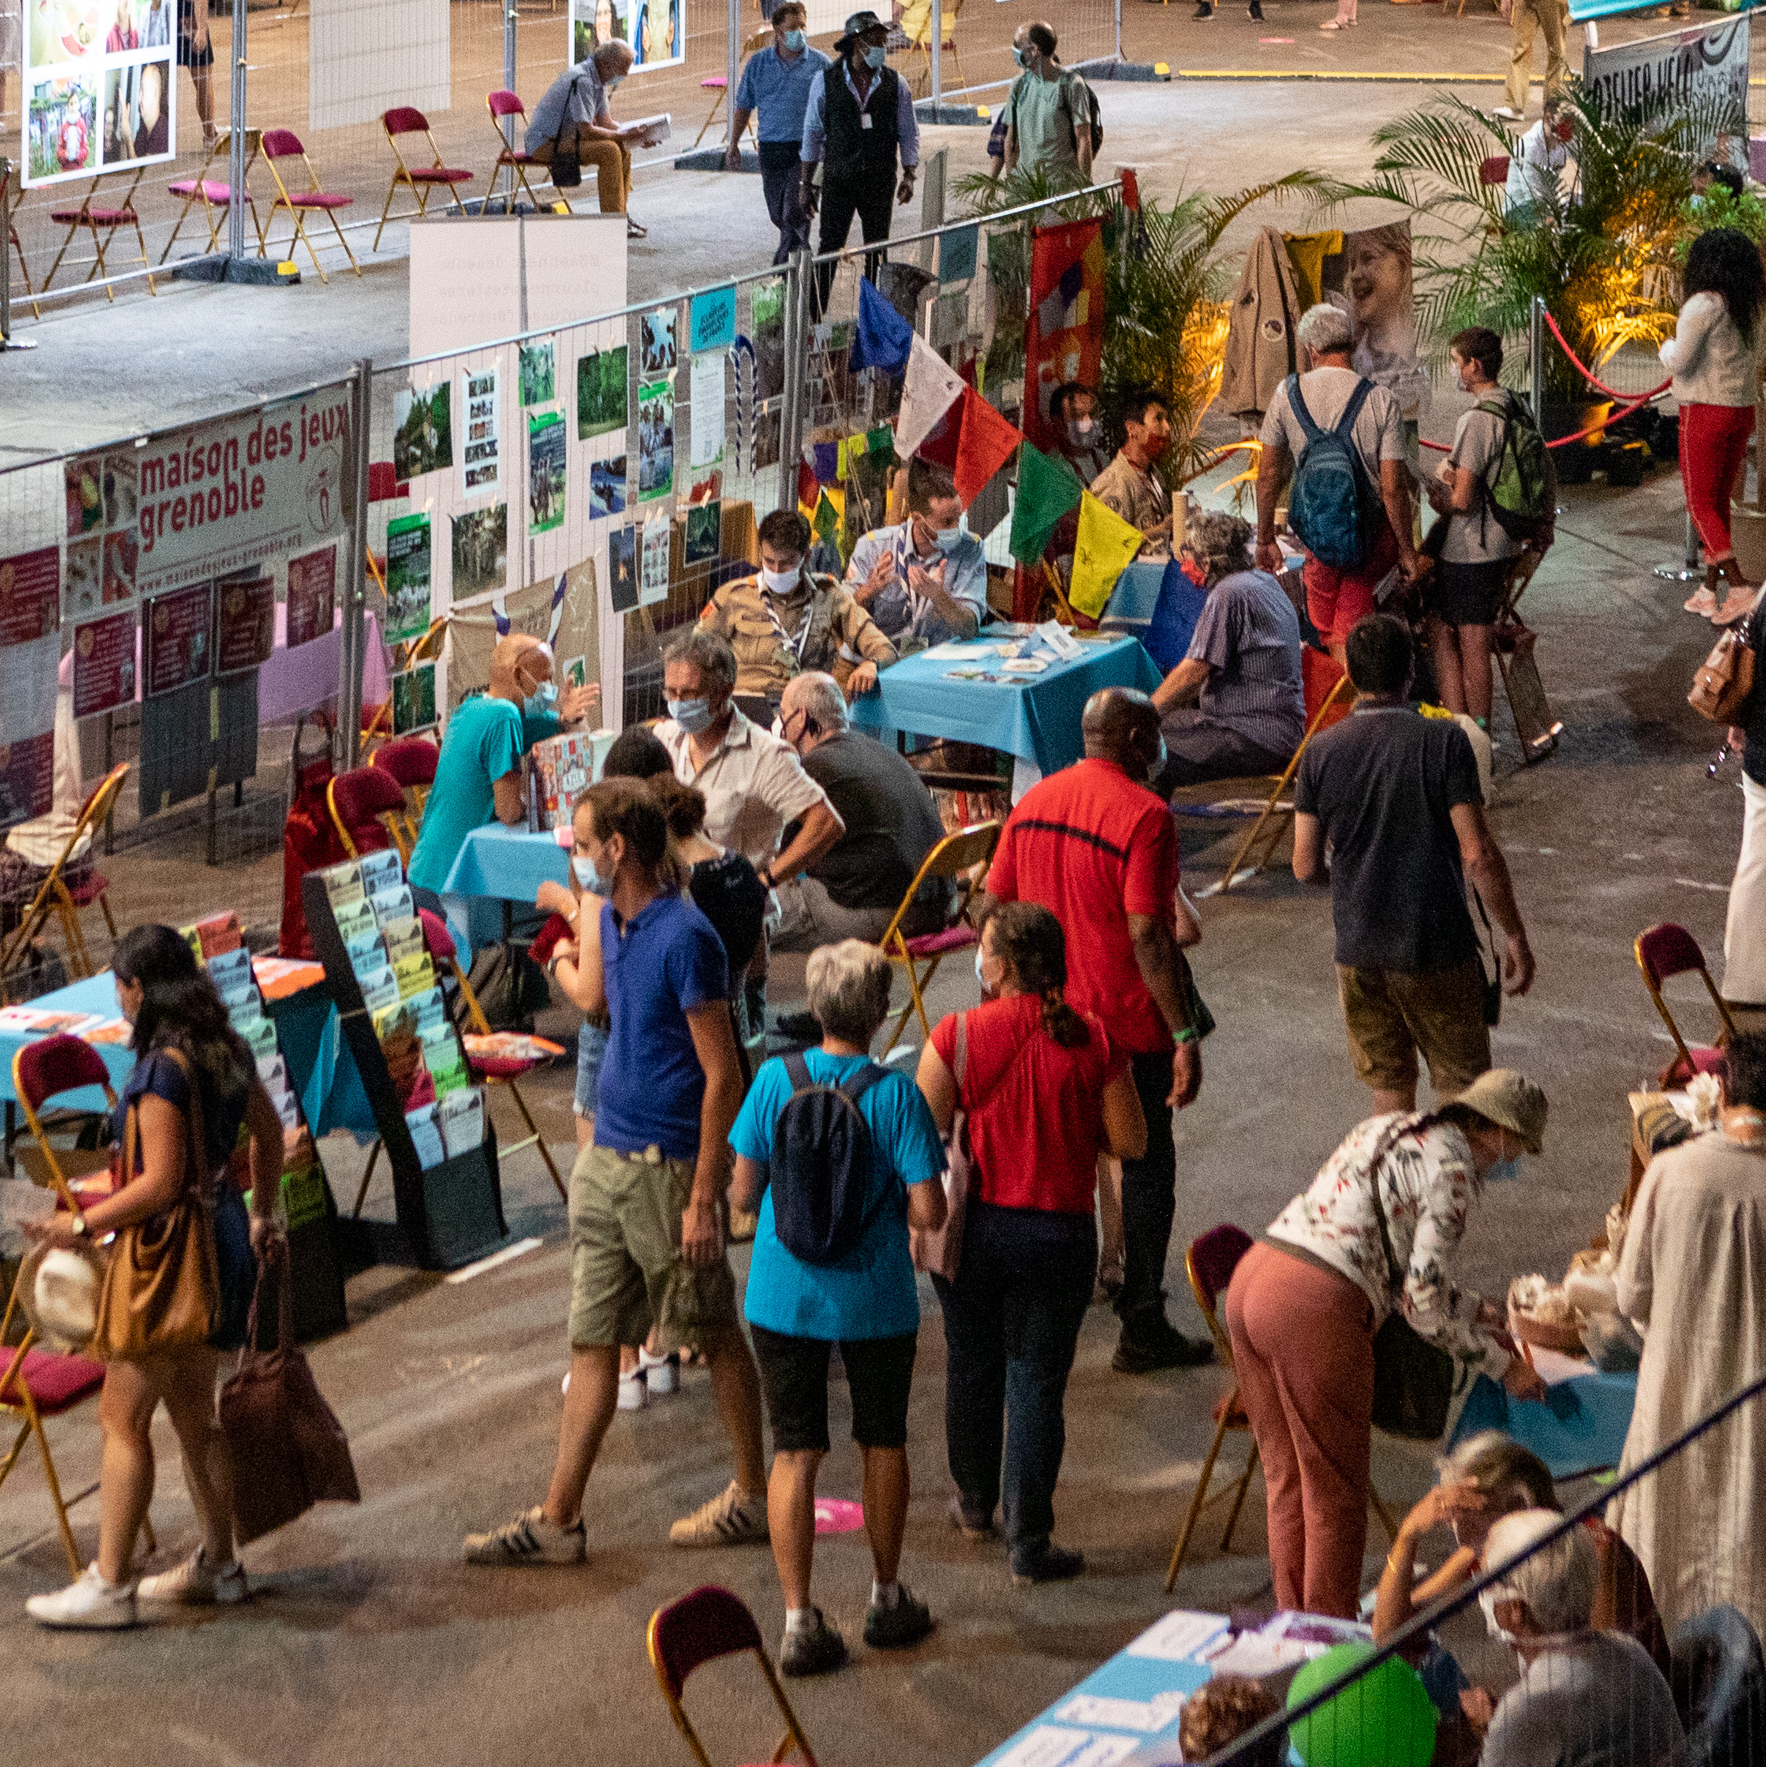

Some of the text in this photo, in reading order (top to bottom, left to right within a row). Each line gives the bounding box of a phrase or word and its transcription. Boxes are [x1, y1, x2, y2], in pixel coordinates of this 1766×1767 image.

[139, 399, 350, 497] maison des jeux
[139, 467, 267, 554] grenoble
